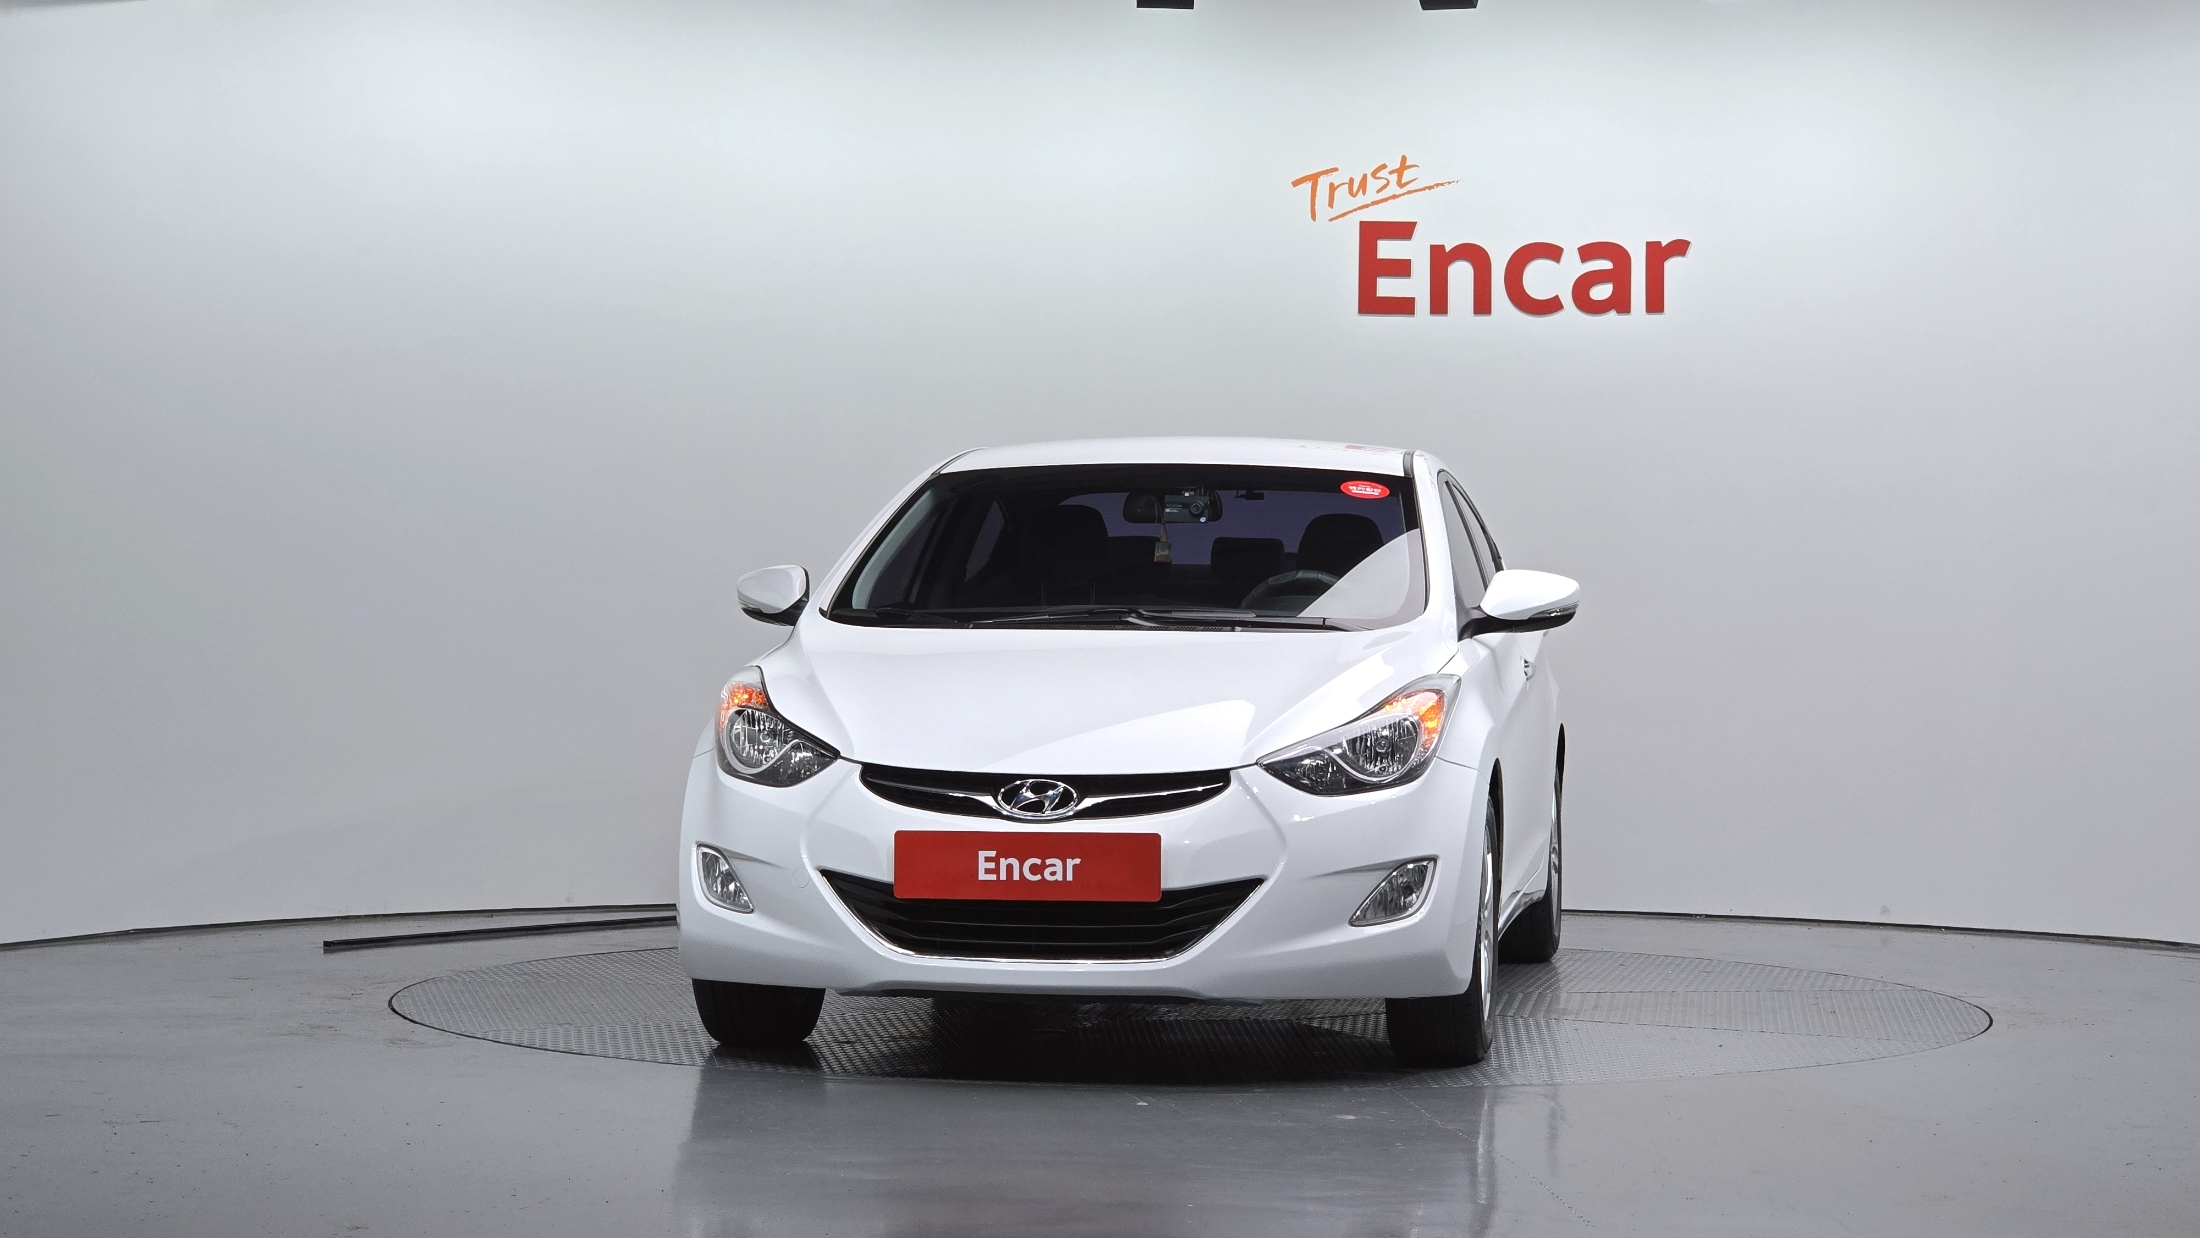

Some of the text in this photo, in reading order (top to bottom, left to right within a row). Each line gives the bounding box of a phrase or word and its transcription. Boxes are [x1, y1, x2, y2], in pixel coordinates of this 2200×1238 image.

[1291, 154, 1420, 222] Trust
[1357, 220, 1692, 316] Encar
[977, 850, 1082, 882] Encar
